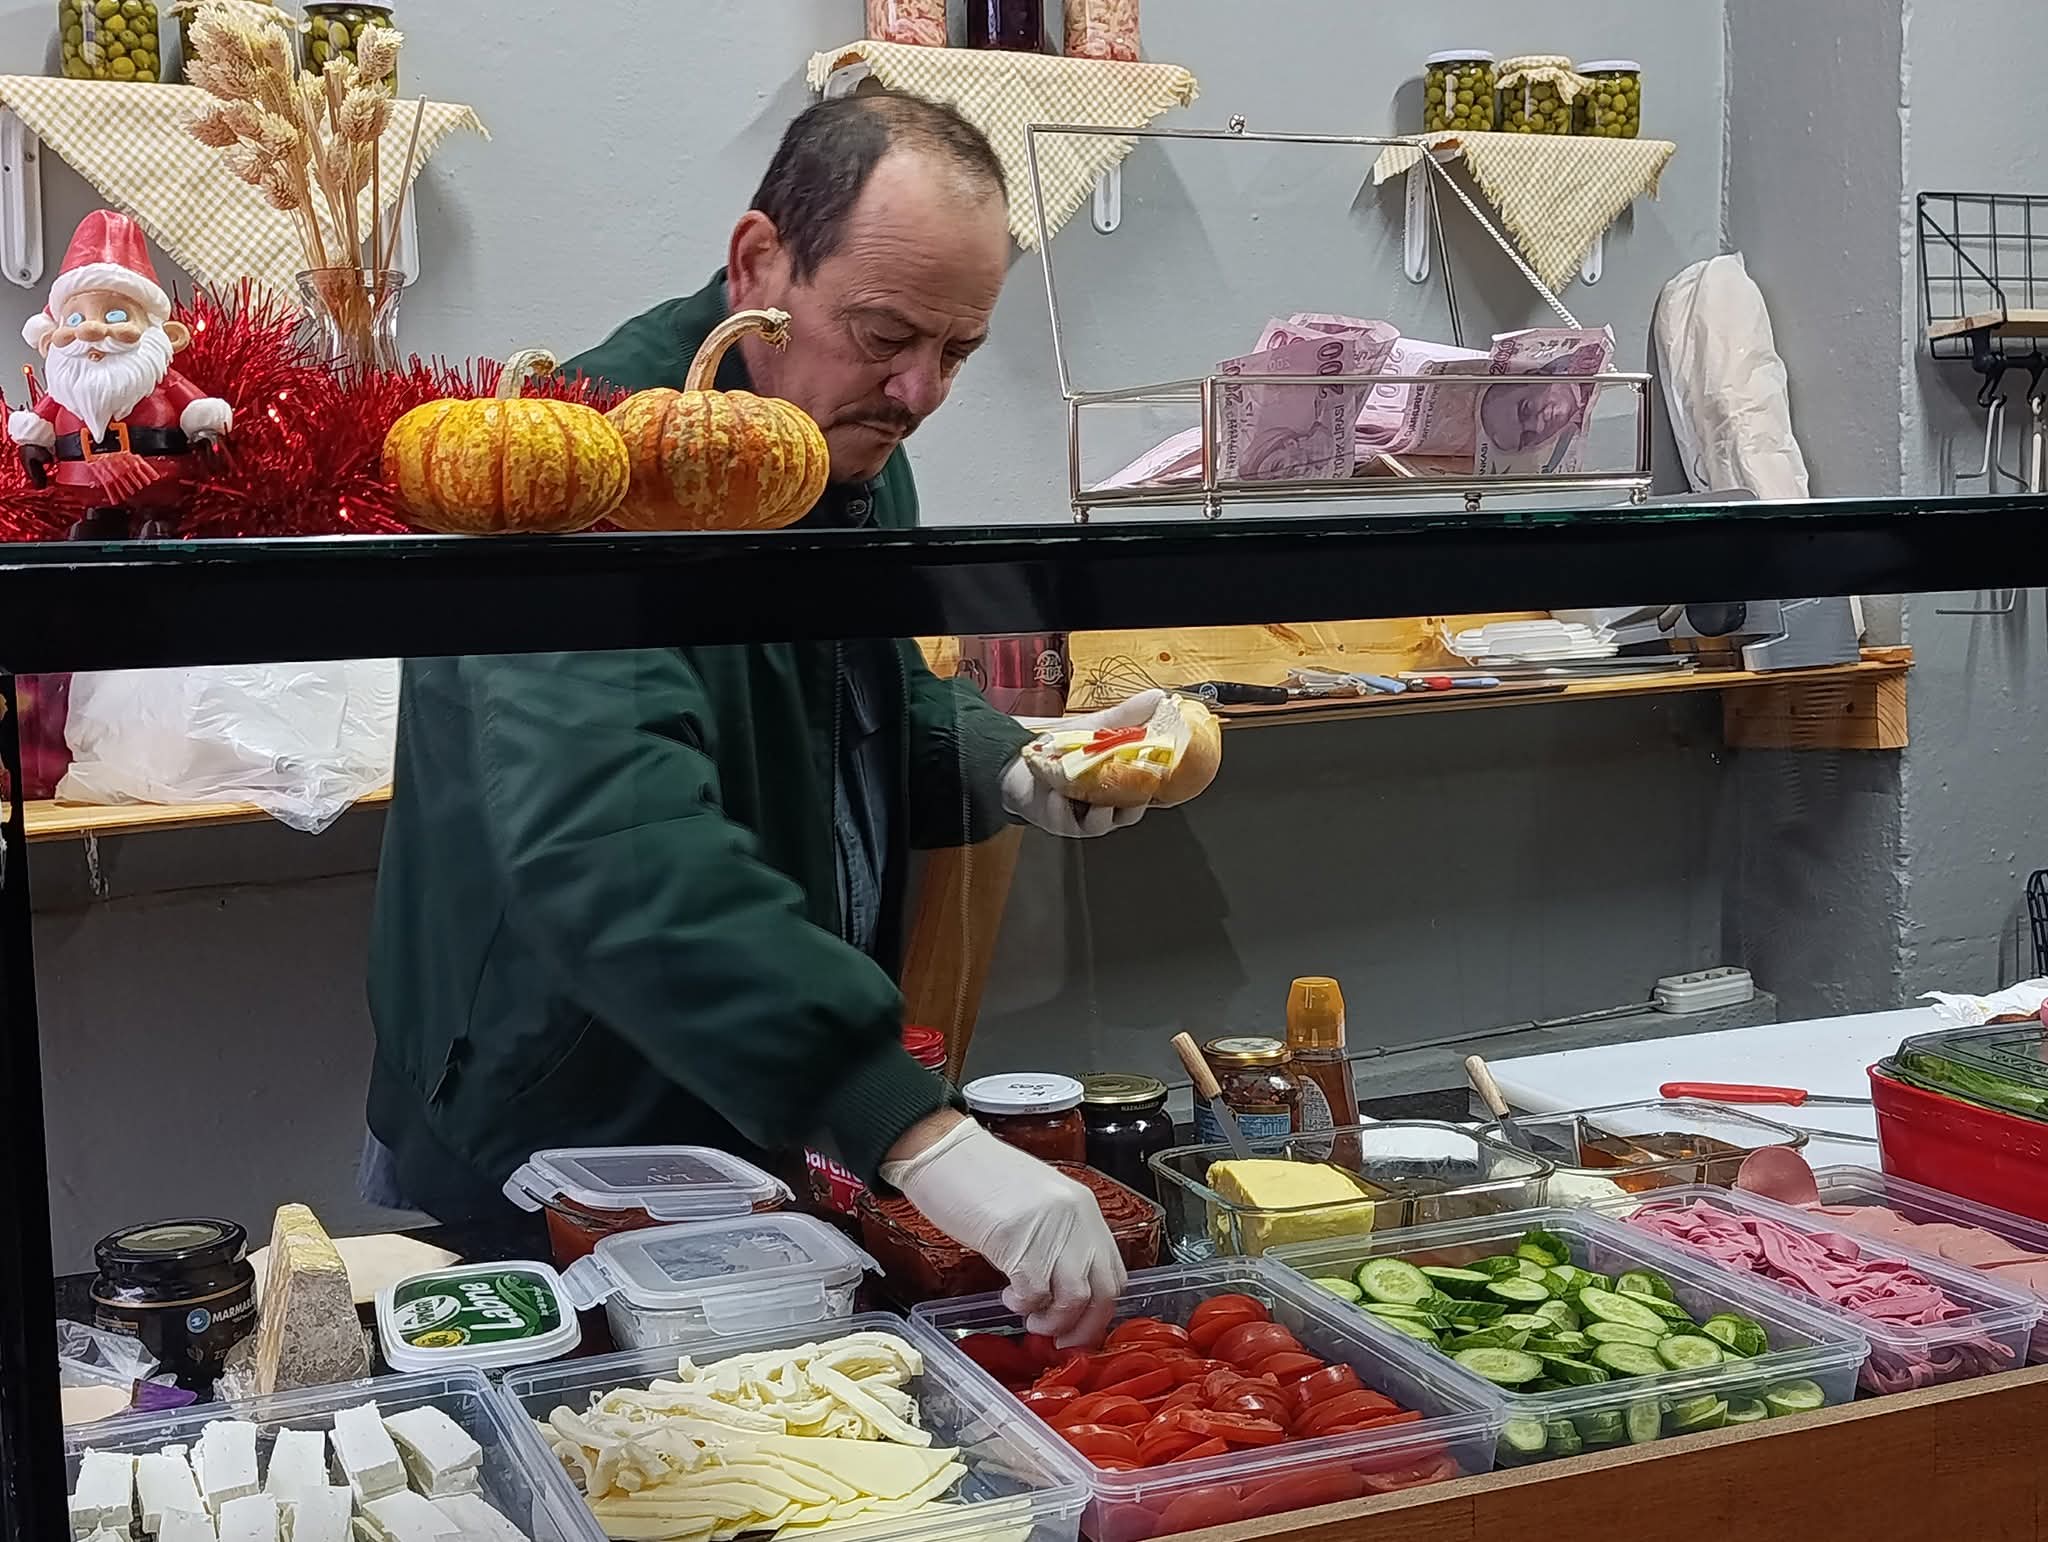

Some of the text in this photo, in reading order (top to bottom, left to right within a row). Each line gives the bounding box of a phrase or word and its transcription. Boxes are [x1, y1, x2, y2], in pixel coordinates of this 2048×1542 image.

[1317, 341, 1344, 399] 200
[1489, 339, 1515, 375] 200
[459, 1282, 526, 1330] Labne
